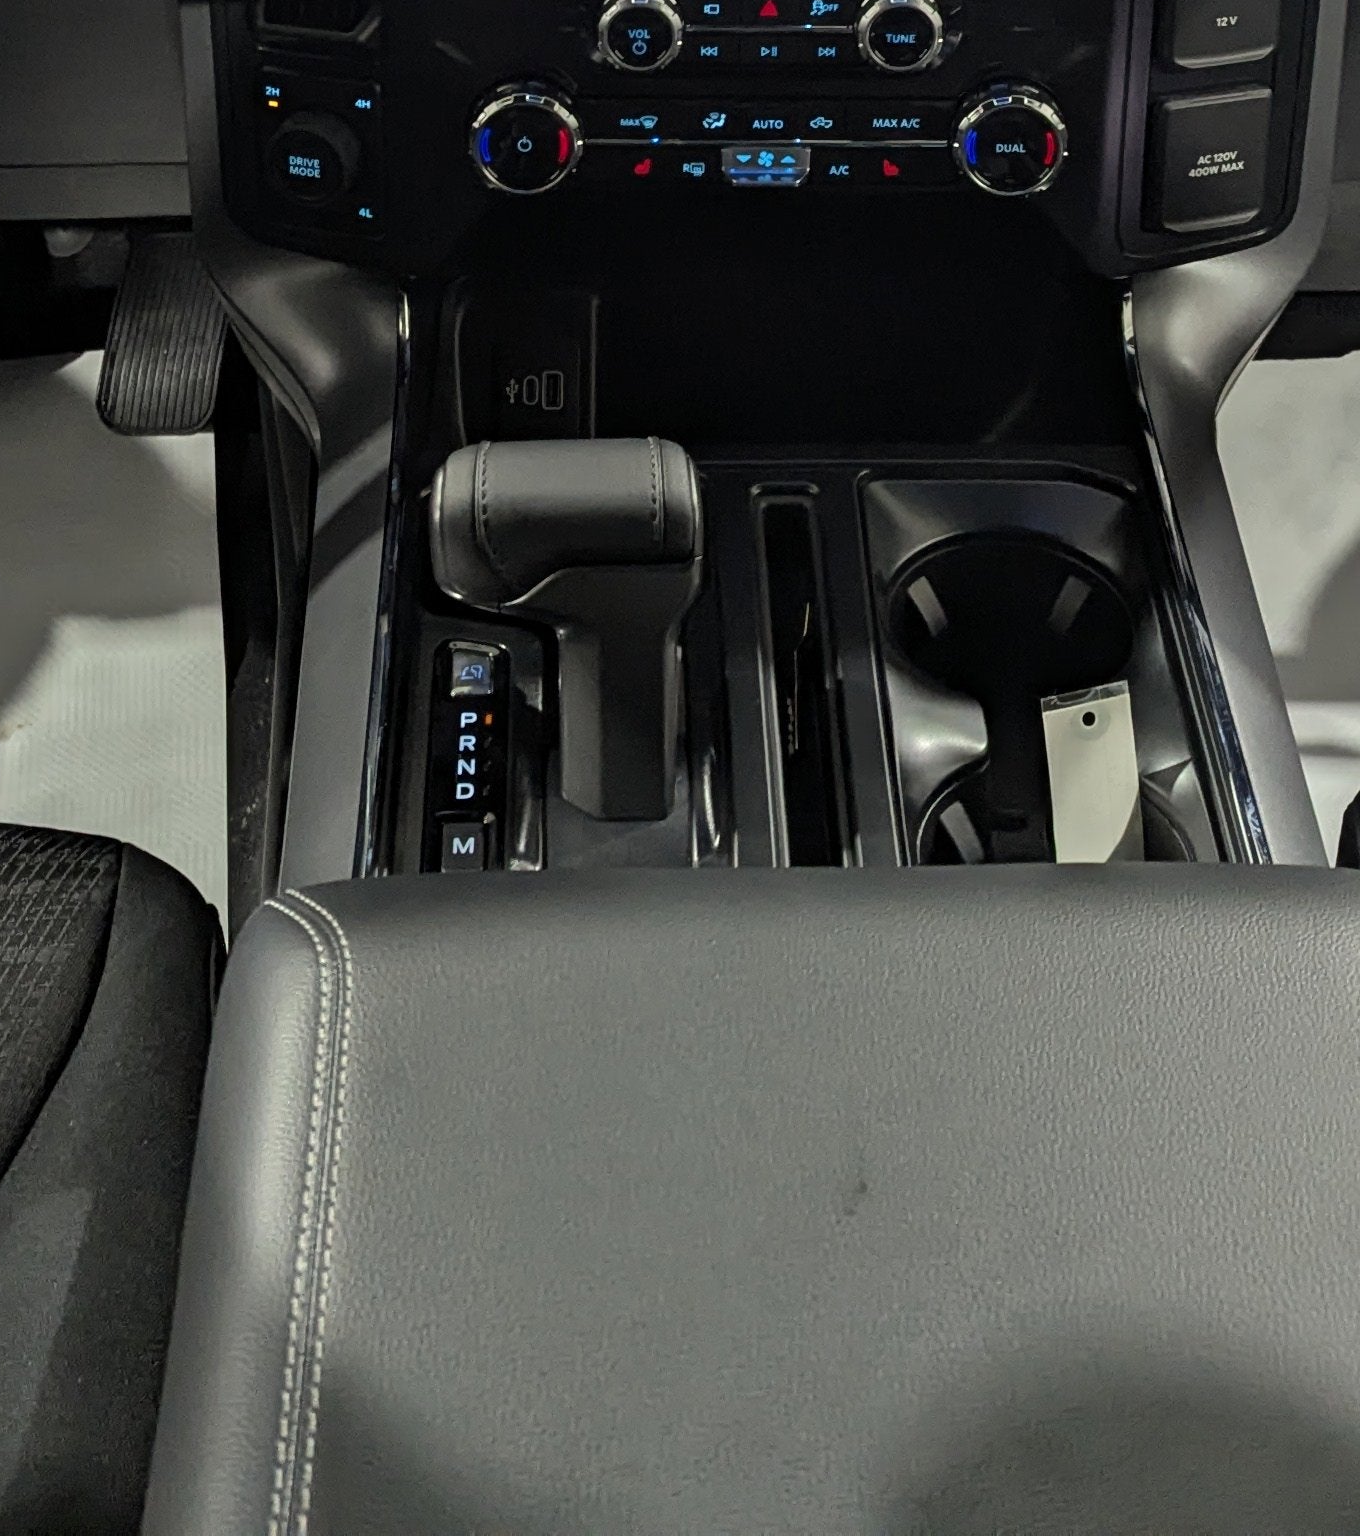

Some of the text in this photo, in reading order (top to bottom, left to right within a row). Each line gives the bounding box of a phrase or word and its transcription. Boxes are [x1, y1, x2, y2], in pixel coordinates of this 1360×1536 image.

[824, 3, 839, 12] OFF
[628, 29, 651, 40] VOL
[885, 34, 916, 44] TUNE
[265, 86, 280, 97] 2H
[354, 98, 371, 110] 4H
[620, 117, 641, 127] MAX
[752, 119, 784, 130] AUTO
[872, 118, 921, 129] MAX A/C
[996, 143, 1026, 154] DUAL
[289, 155, 320, 168] DRIVE
[1197, 150, 1238, 166] AC 120V
[289, 166, 321, 179] MODE
[829, 164, 850, 175] A/C
[1188, 160, 1245, 178] 400W MAX
[358, 208, 373, 219] 4L
[460, 712, 477, 728] P
[458, 735, 476, 752] R
[457, 758, 475, 775] N
[455, 783, 475, 799] D
[452, 837, 475, 855] M
